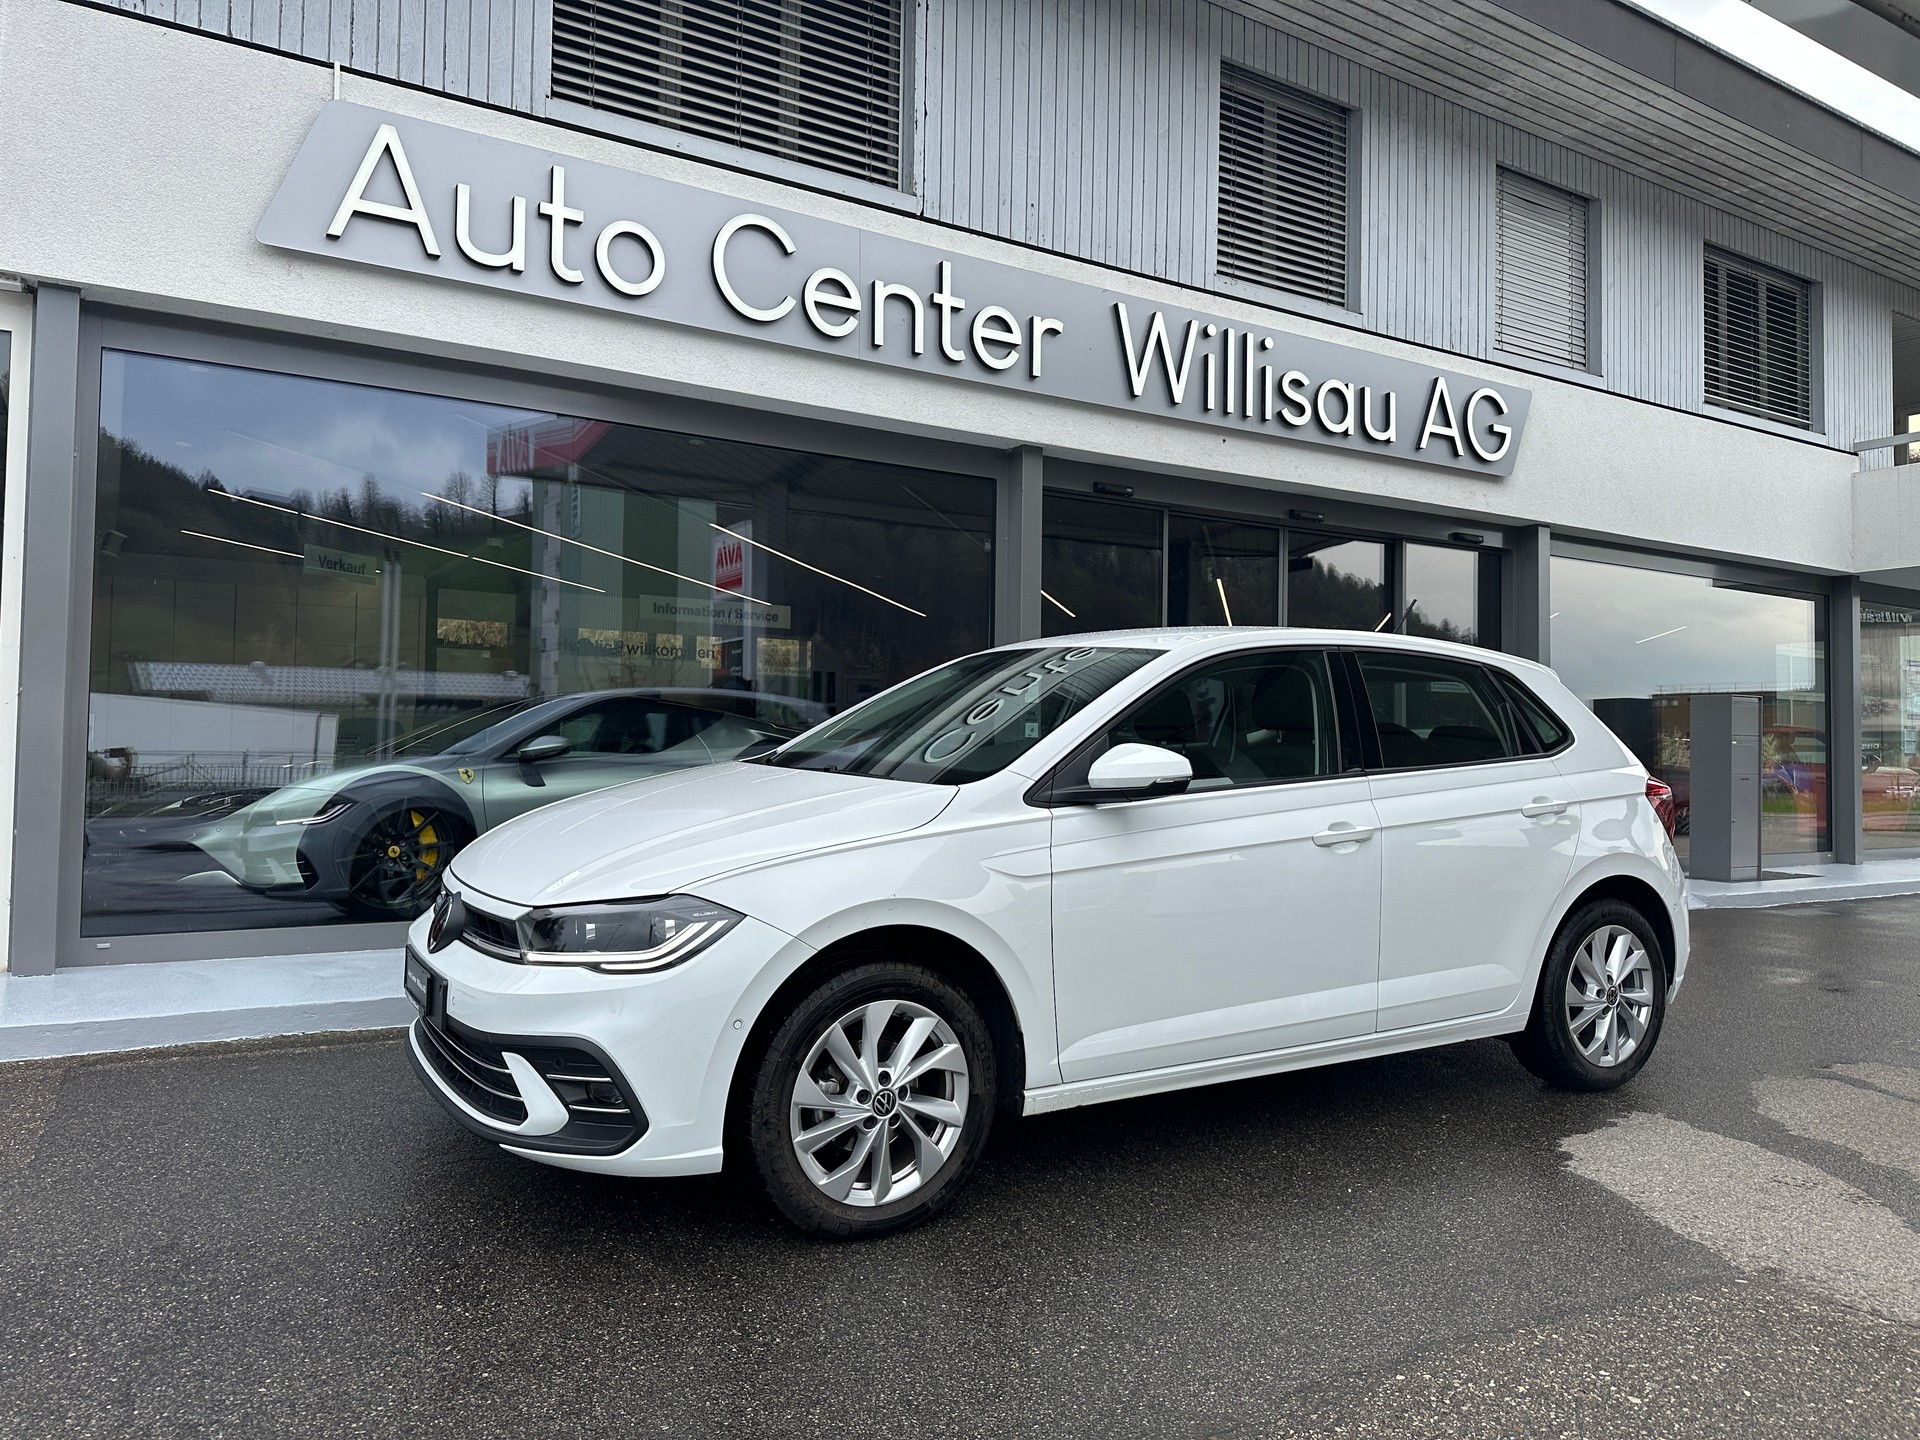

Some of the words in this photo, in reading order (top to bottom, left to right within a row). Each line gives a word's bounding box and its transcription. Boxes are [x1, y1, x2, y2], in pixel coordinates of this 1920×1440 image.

[326, 123, 666, 297] Auto
[711, 213, 1064, 378] Center
[1114, 302, 1396, 443] Willisau
[1416, 376, 1512, 462] AG
[318, 554, 366, 575] Verkauf
[652, 602, 725, 618] Information
[734, 608, 779, 622] Service
